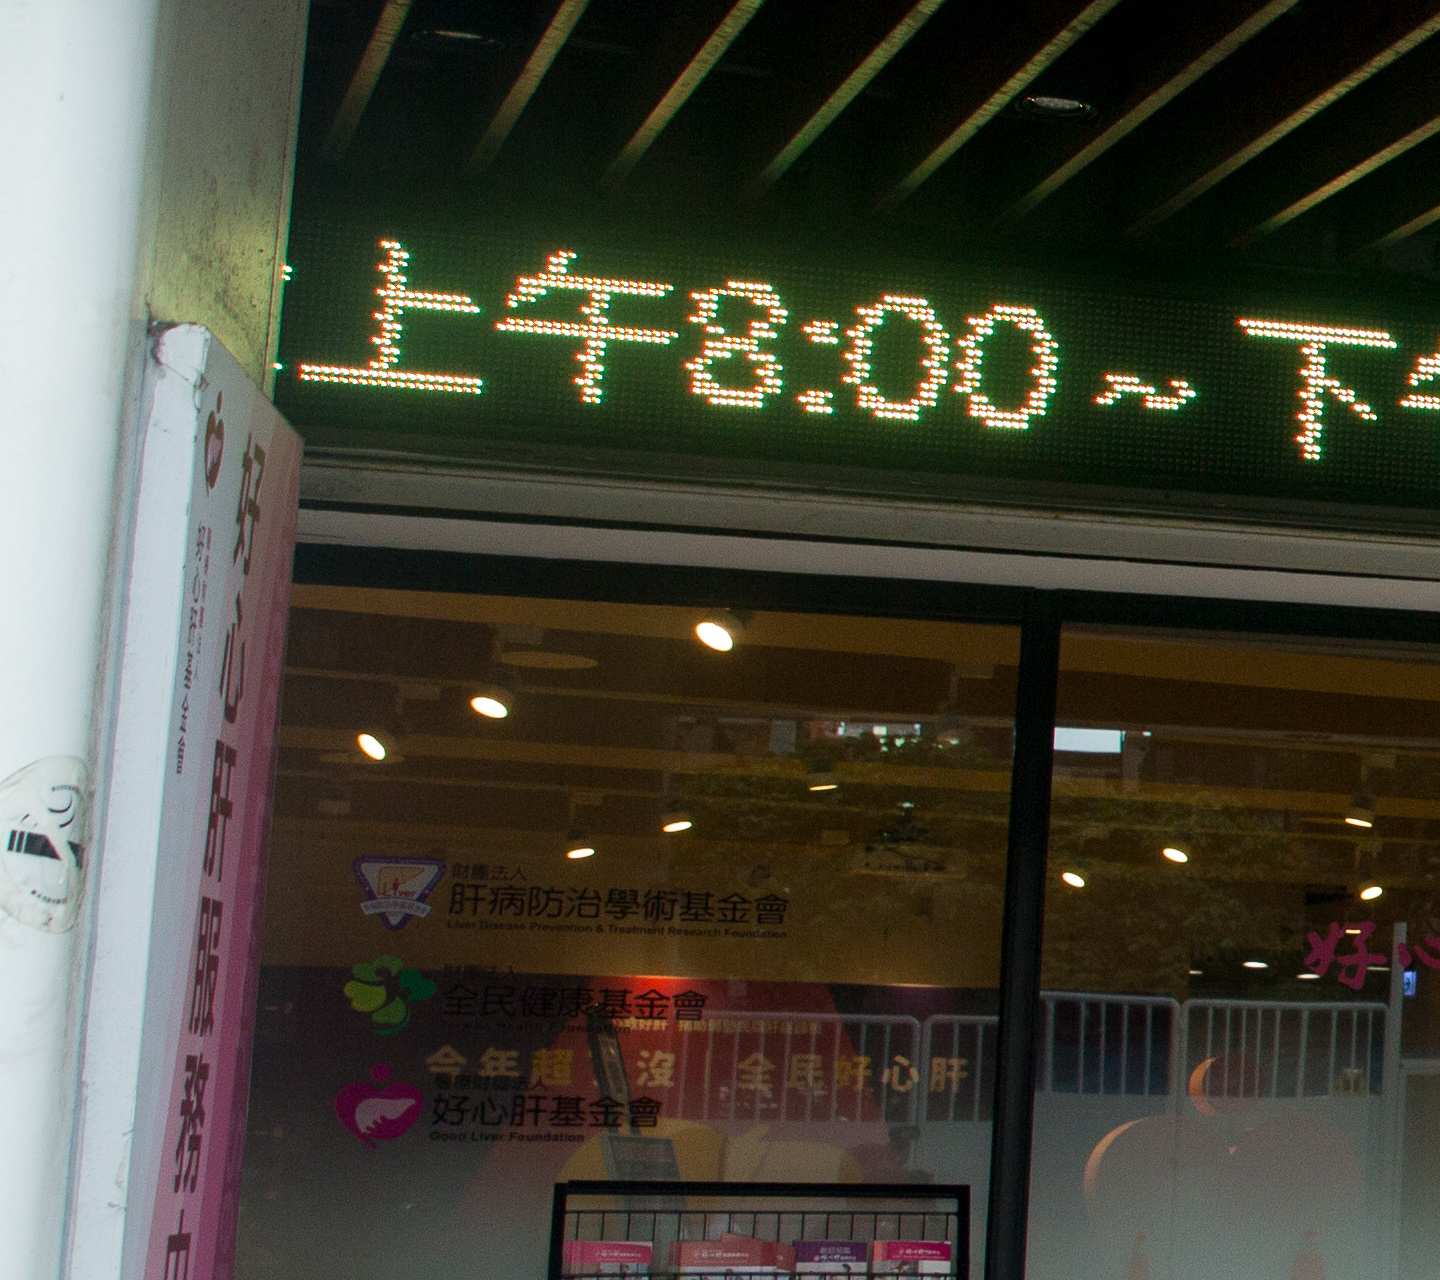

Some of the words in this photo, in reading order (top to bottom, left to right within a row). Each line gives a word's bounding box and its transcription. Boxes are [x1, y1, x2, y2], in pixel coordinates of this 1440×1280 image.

[447, 883, 791, 926] 肝病防治學術基金會
[442, 984, 708, 1022] 全民健康基金會
[431, 1092, 664, 1130] 好心肝基金會
